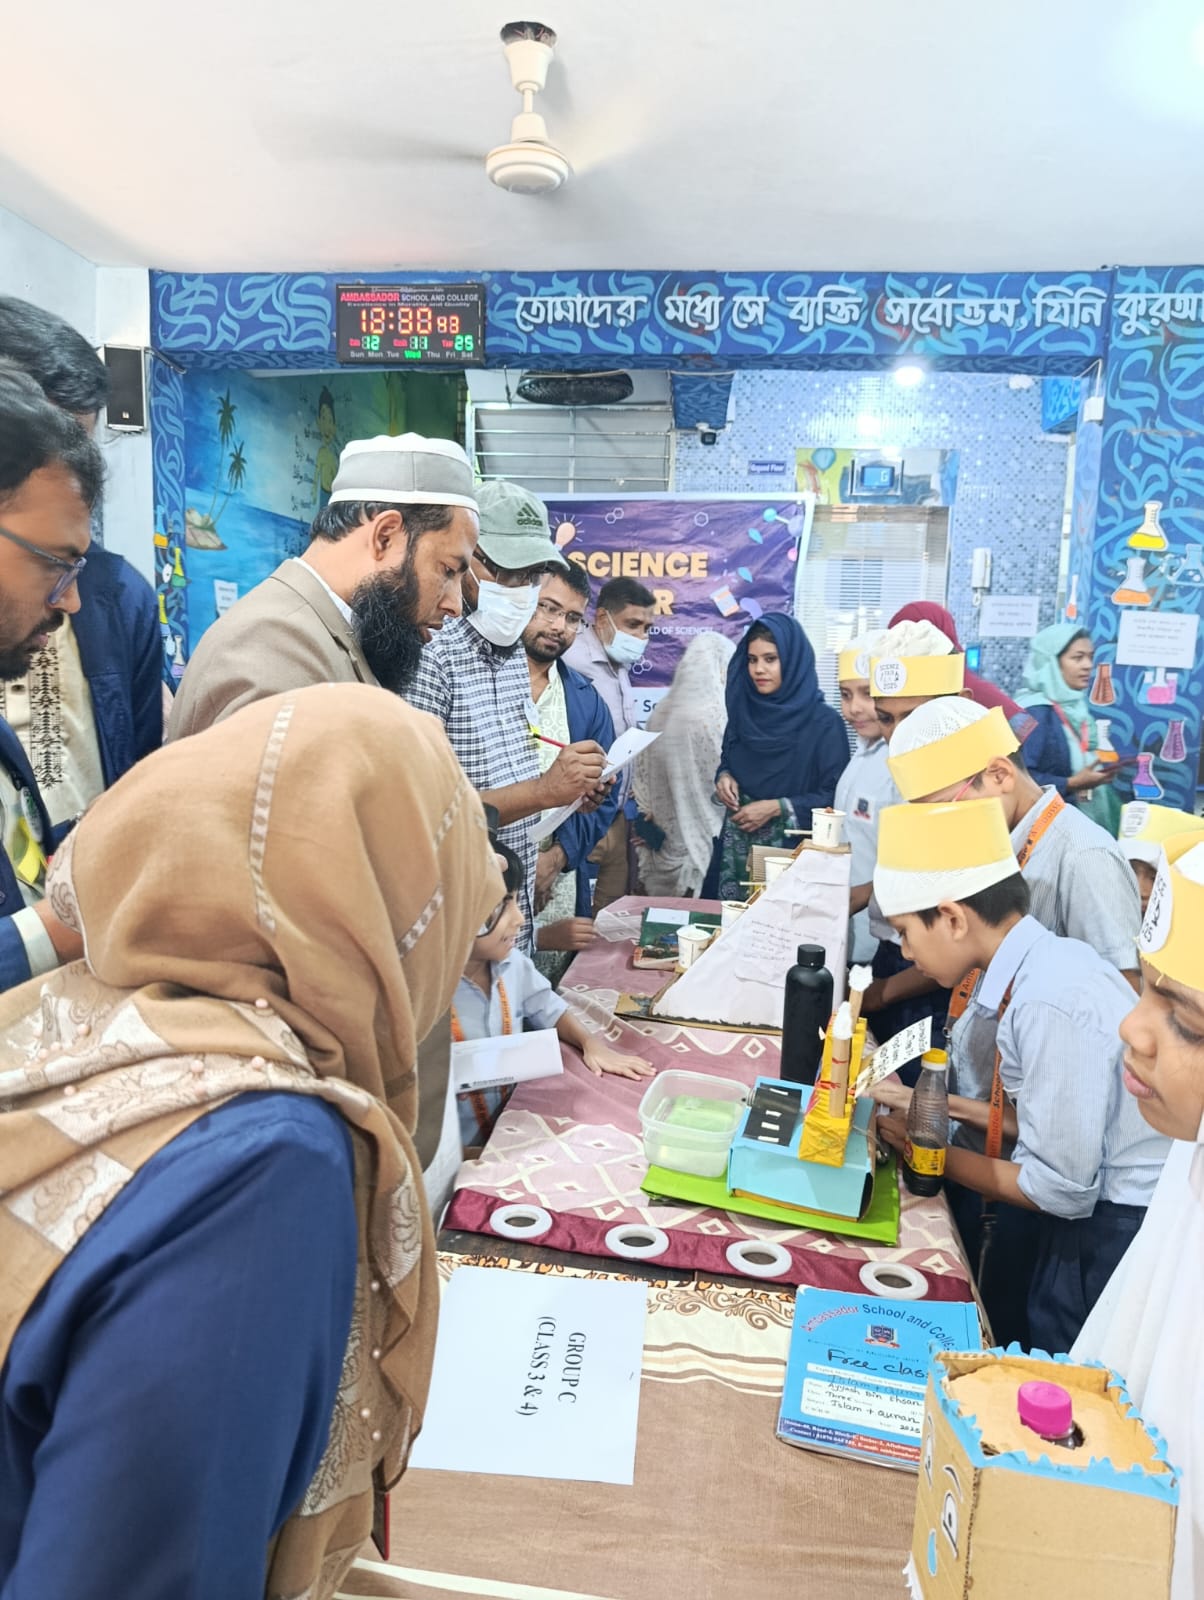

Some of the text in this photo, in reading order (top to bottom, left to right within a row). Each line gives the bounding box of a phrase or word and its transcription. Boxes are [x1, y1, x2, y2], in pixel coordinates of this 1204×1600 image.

[340, 292, 479, 302] AMBASSADOR SCHOOL AND COLLEGE
[515, 293, 648, 332] তোমাদের
[664, 295, 725, 331] মধ্যে
[731, 296, 770, 330] সে
[786, 285, 863, 332] ব্যক্তি
[1032, 286, 1107, 330] যিনি
[454, 335, 474, 351] 25
[567, 551, 709, 578] SCIENCE
[662, 626, 673, 635] OF
[862, 1303, 907, 1320] School
[906, 1313, 932, 1329] and
[929, 1326, 956, 1351] Colle
[515, 1316, 557, 1416] (CLASS 3 & 4)
[558, 1332, 587, 1404] GROUP C
[827, 1348, 877, 1372] Free
[829, 1399, 863, 1412] Islam
